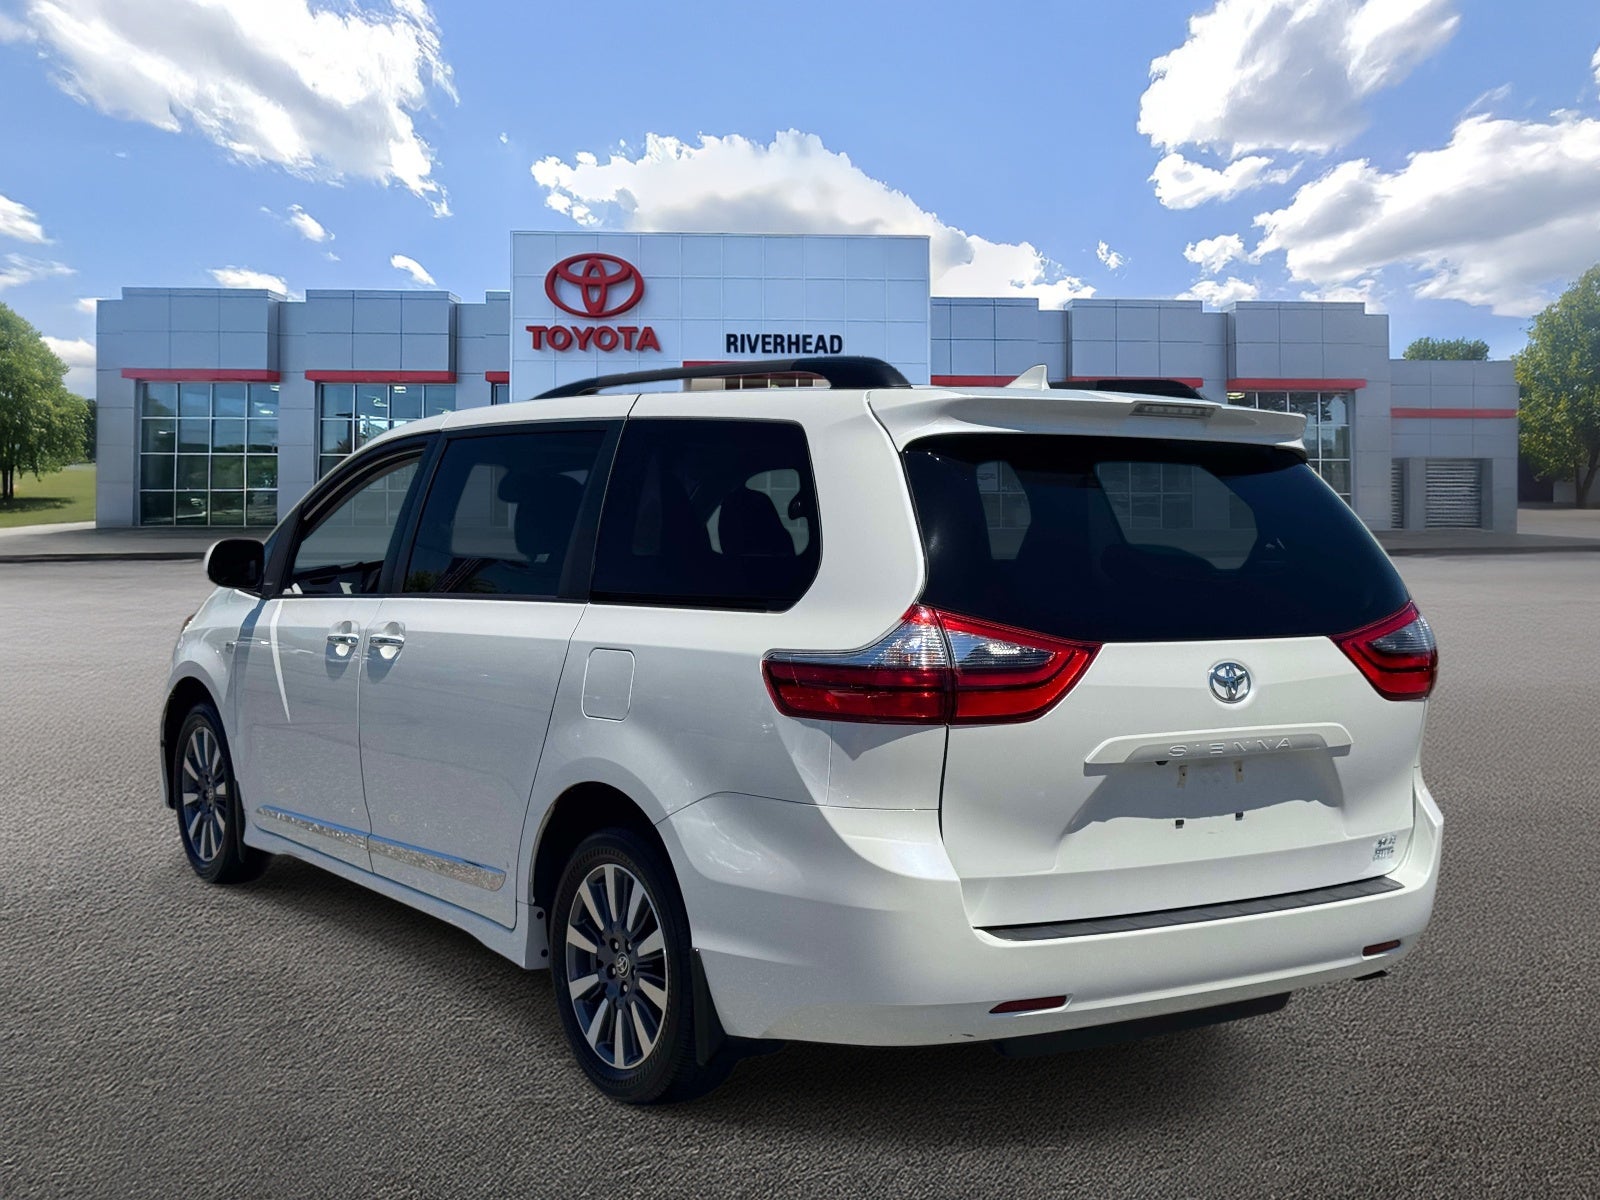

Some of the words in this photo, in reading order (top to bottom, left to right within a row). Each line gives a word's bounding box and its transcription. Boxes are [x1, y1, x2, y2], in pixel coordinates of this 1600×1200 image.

[526, 325, 661, 352] TOYOTA
[726, 333, 843, 354] RIVERHEAD
[1168, 737, 1293, 757] SENNA
